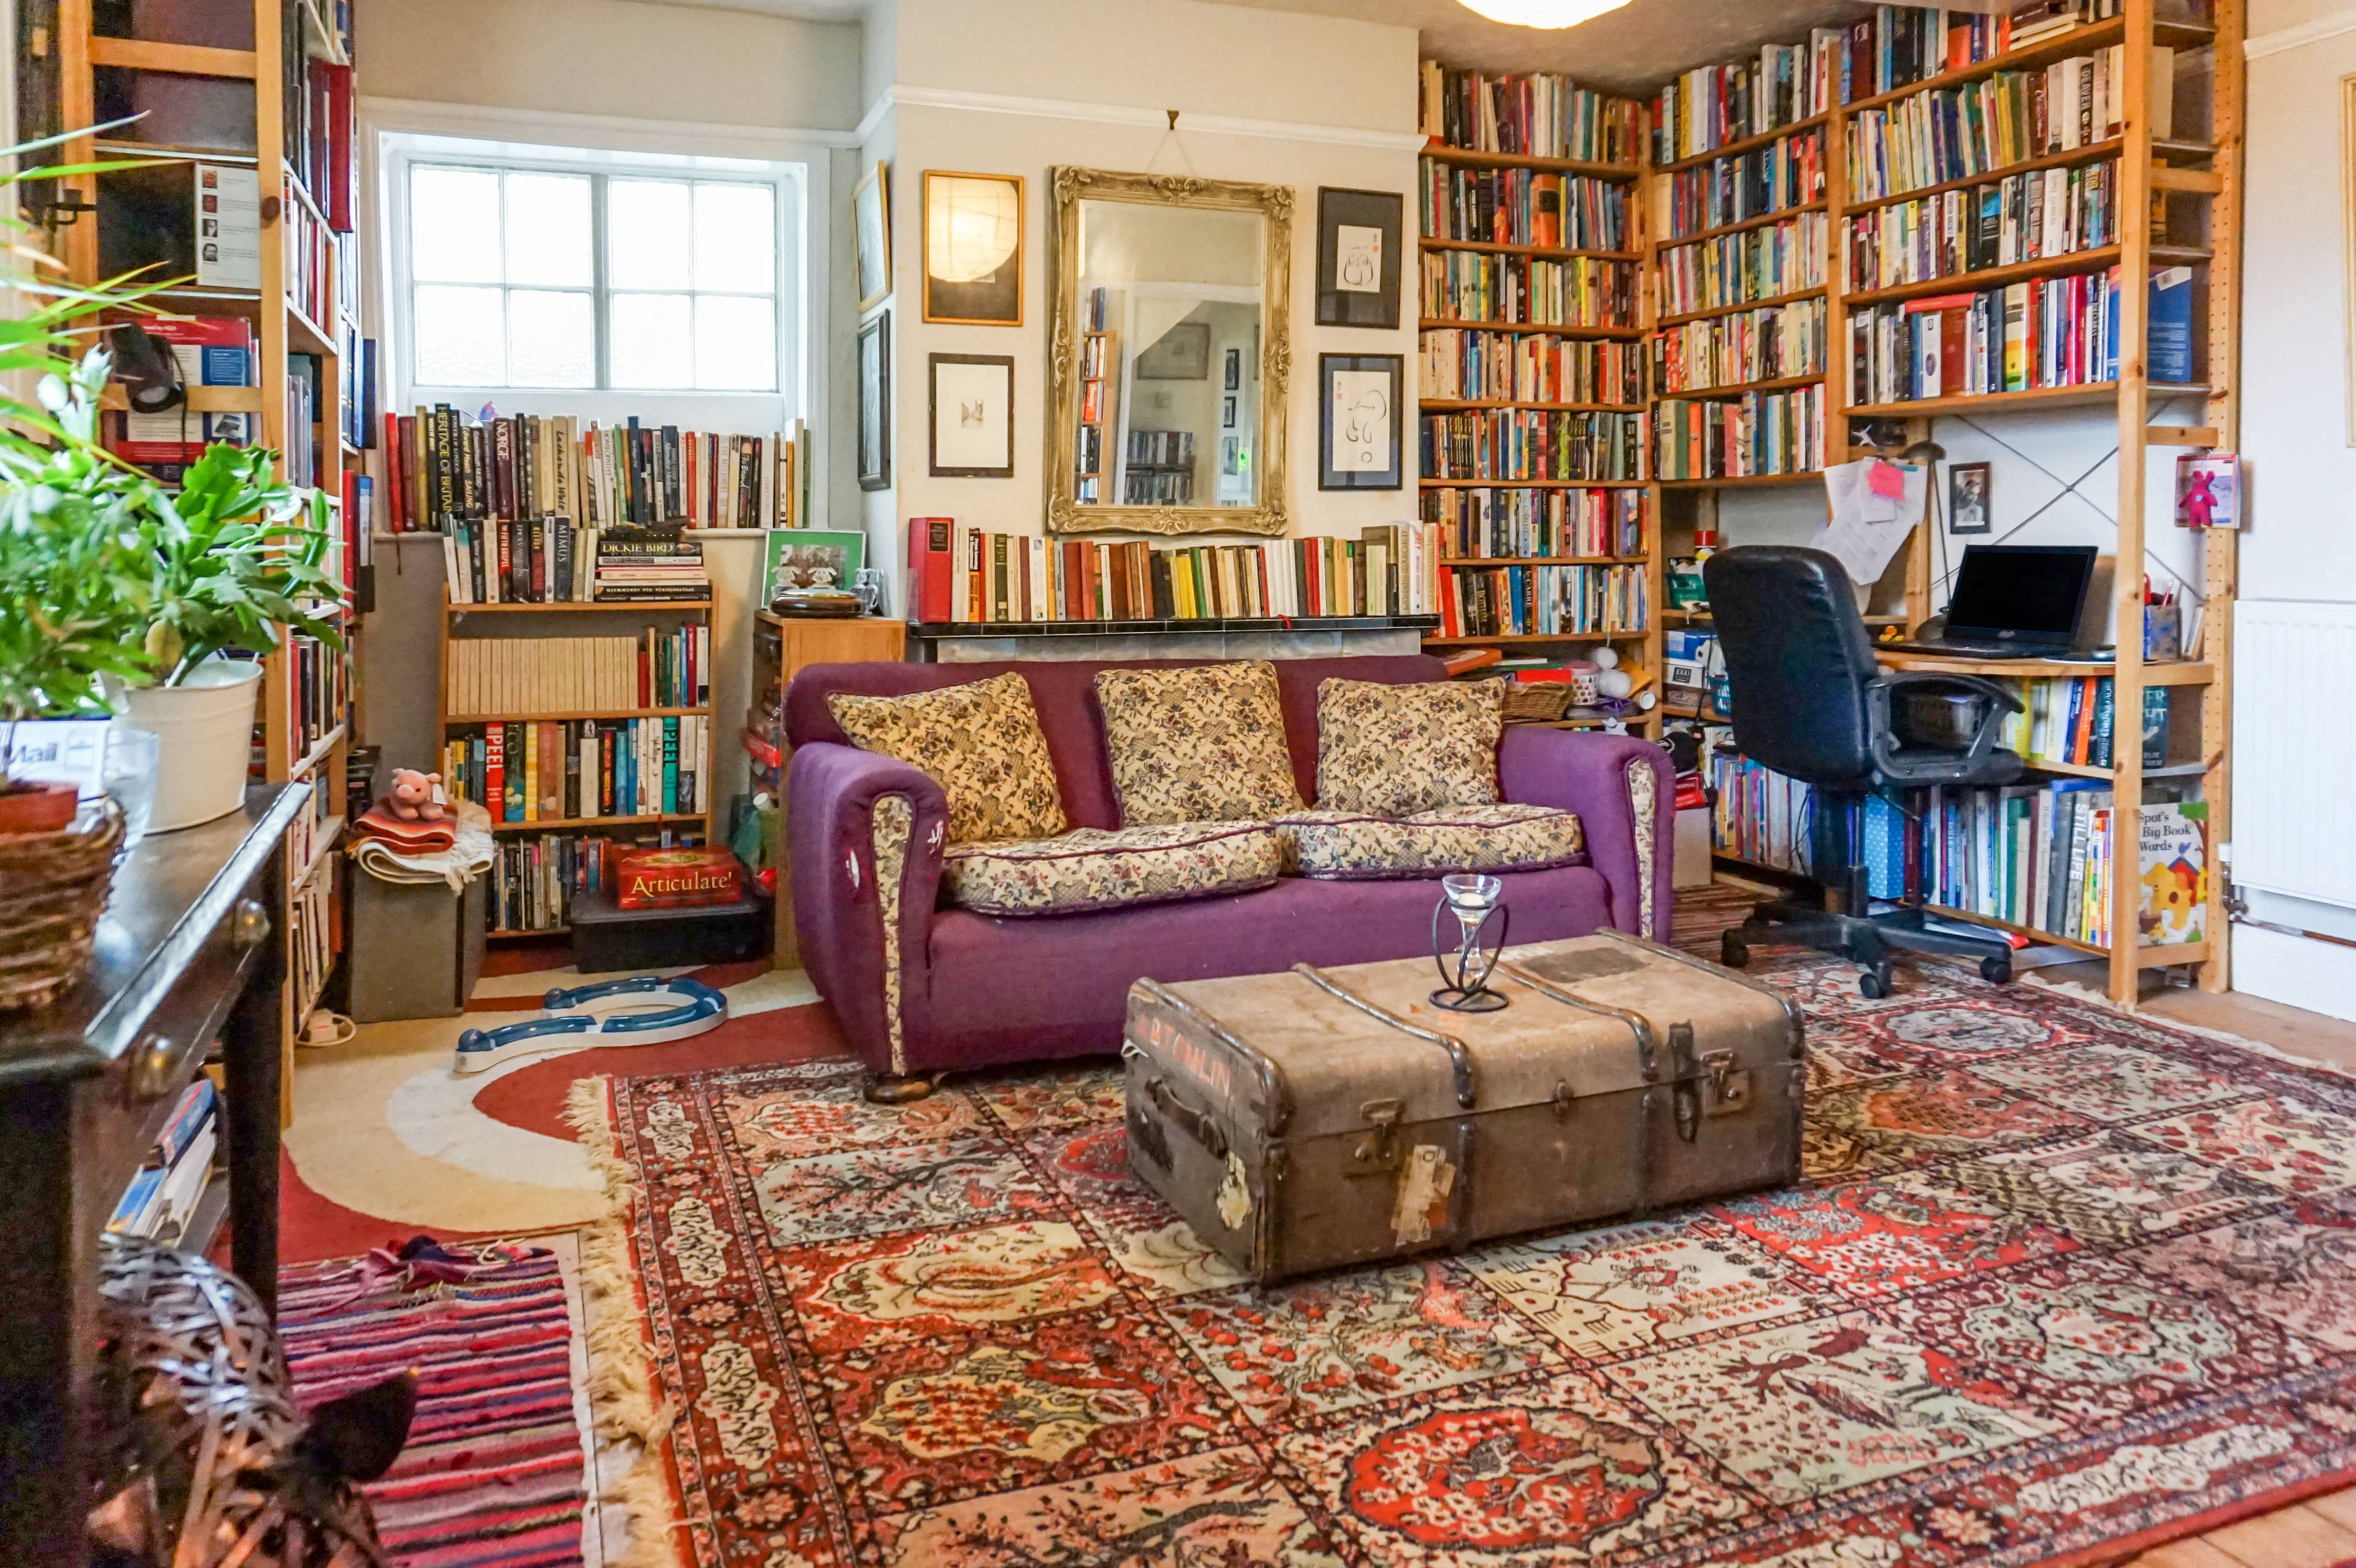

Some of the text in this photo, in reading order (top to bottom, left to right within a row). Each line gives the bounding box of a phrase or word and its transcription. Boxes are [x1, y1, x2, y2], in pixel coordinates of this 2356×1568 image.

[2081, 69, 2091, 109] DEAVER
[462, 427, 471, 451] Edward
[497, 421, 509, 460] NORGE
[437, 407, 452, 515] HERITAGE OF BRITAIN
[464, 480, 473, 507] SAILING
[558, 525, 568, 561] MIMUS
[602, 544, 673, 552] DICKIE BIRD
[487, 735, 503, 772] PEEL
[663, 729, 678, 767] PEEL
[2070, 803, 2088, 882] STILL LIFE
[2142, 824, 2191, 839] Big Book
[631, 872, 731, 897] Articulate!
